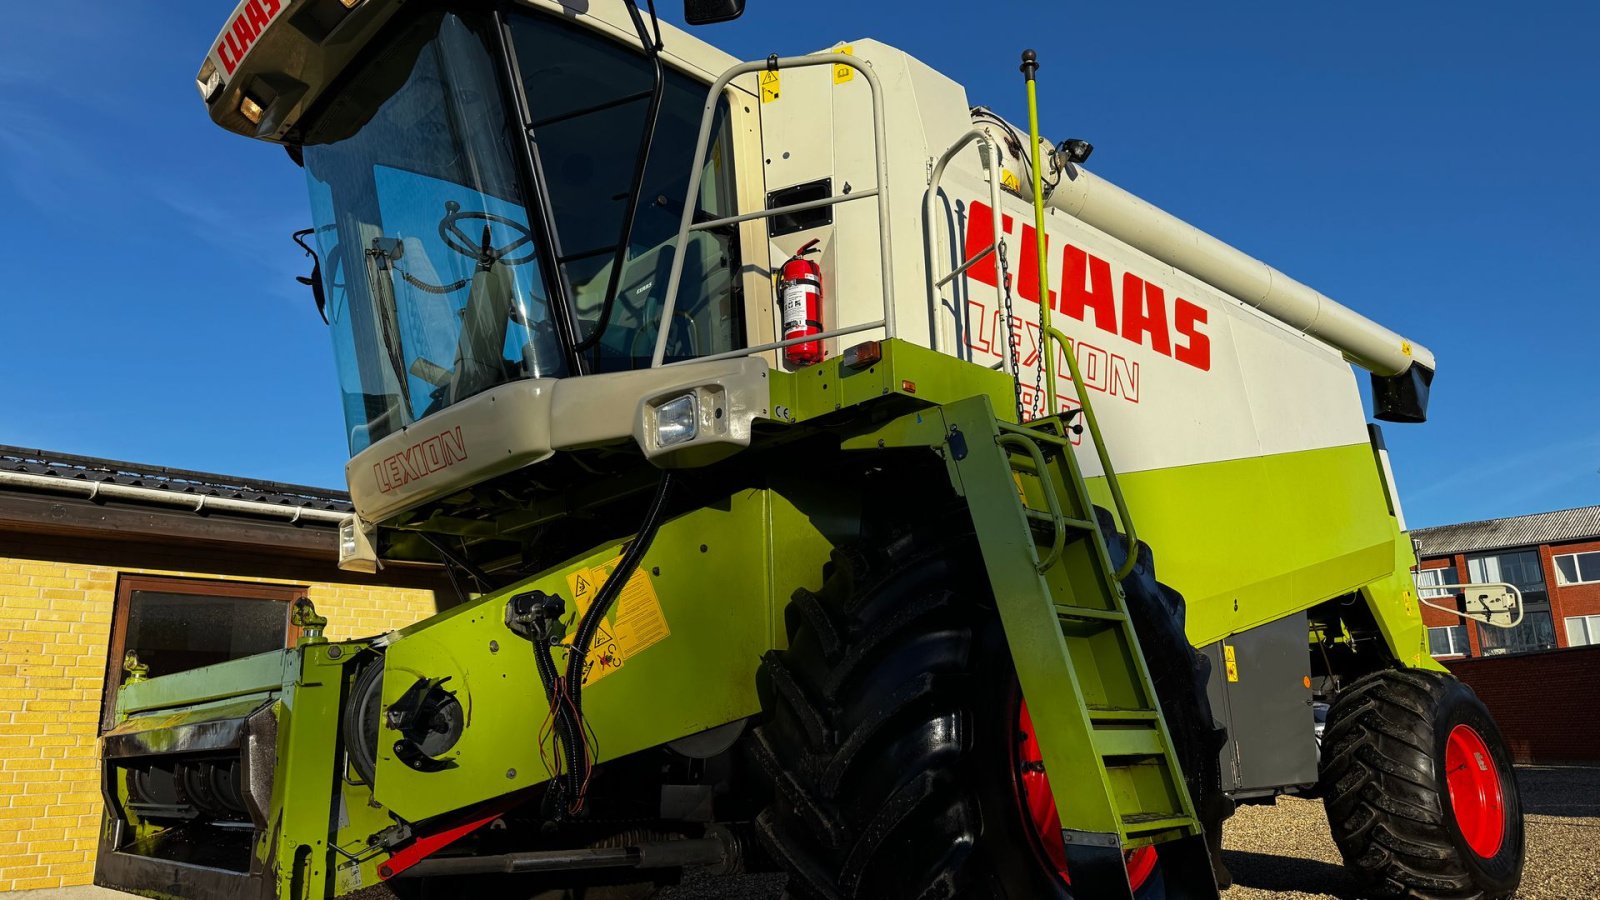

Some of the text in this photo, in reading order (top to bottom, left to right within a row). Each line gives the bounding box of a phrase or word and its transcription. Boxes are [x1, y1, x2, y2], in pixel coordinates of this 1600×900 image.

[217, 0, 281, 76] CLAAS
[965, 200, 1211, 372] CLAAS
[963, 300, 1140, 404] LEXION
[373, 425, 468, 494] LEXION
